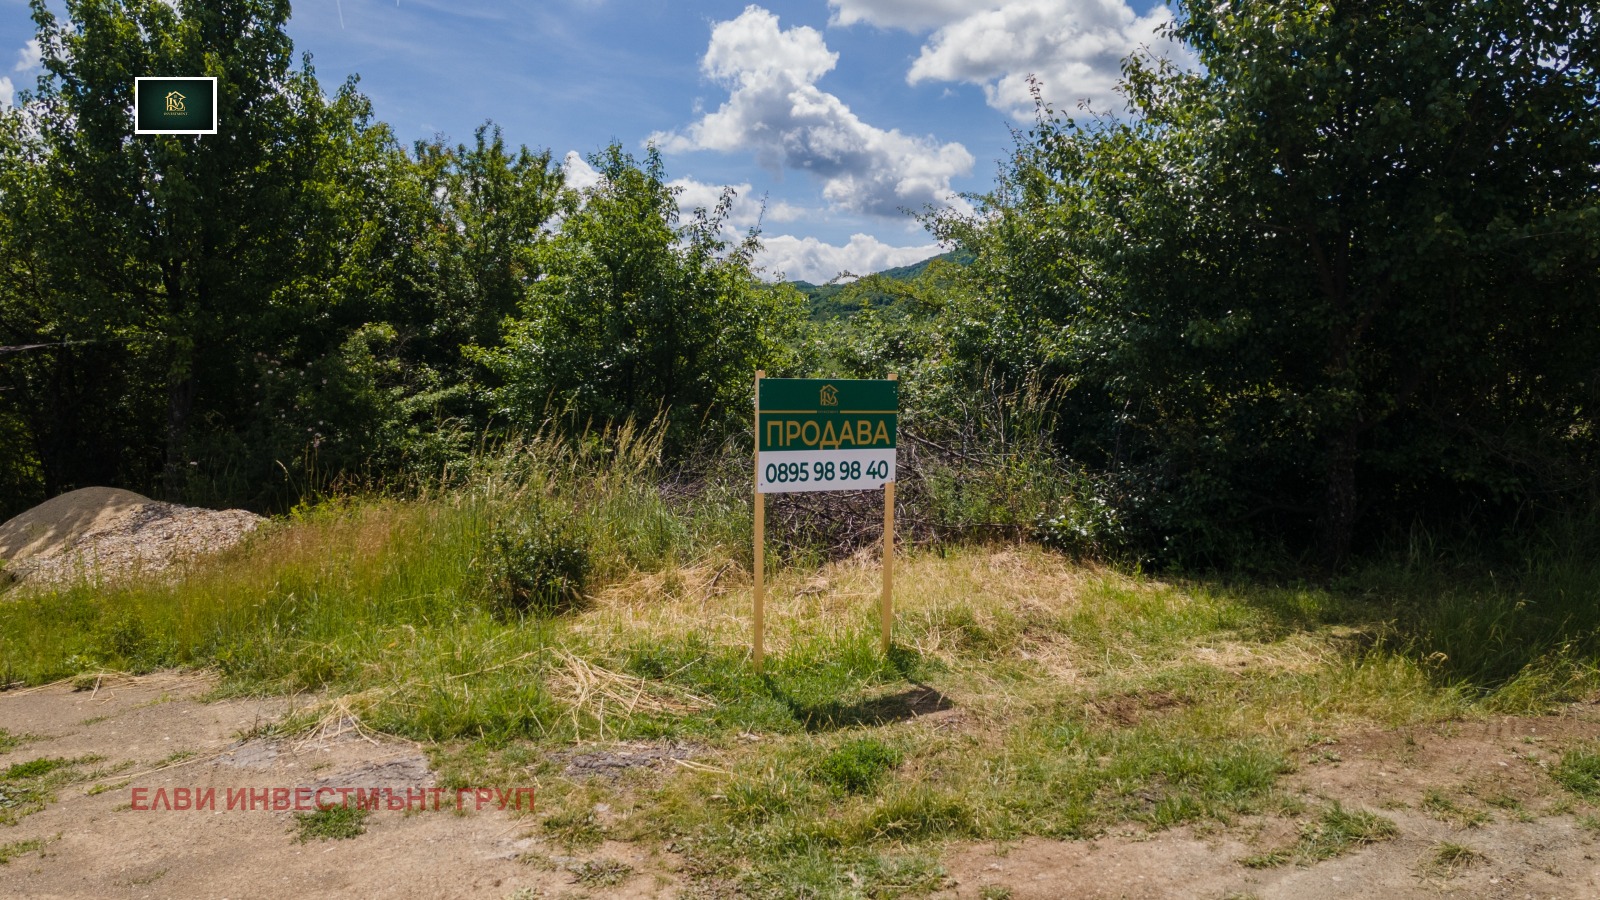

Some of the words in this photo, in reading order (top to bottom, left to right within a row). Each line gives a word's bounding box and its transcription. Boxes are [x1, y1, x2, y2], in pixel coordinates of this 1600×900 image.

[766, 420, 891, 450] ПРОДАВА
[765, 462, 810, 483] 0895
[813, 461, 836, 482] 98
[839, 460, 862, 481] 98
[865, 459, 889, 480] 40
